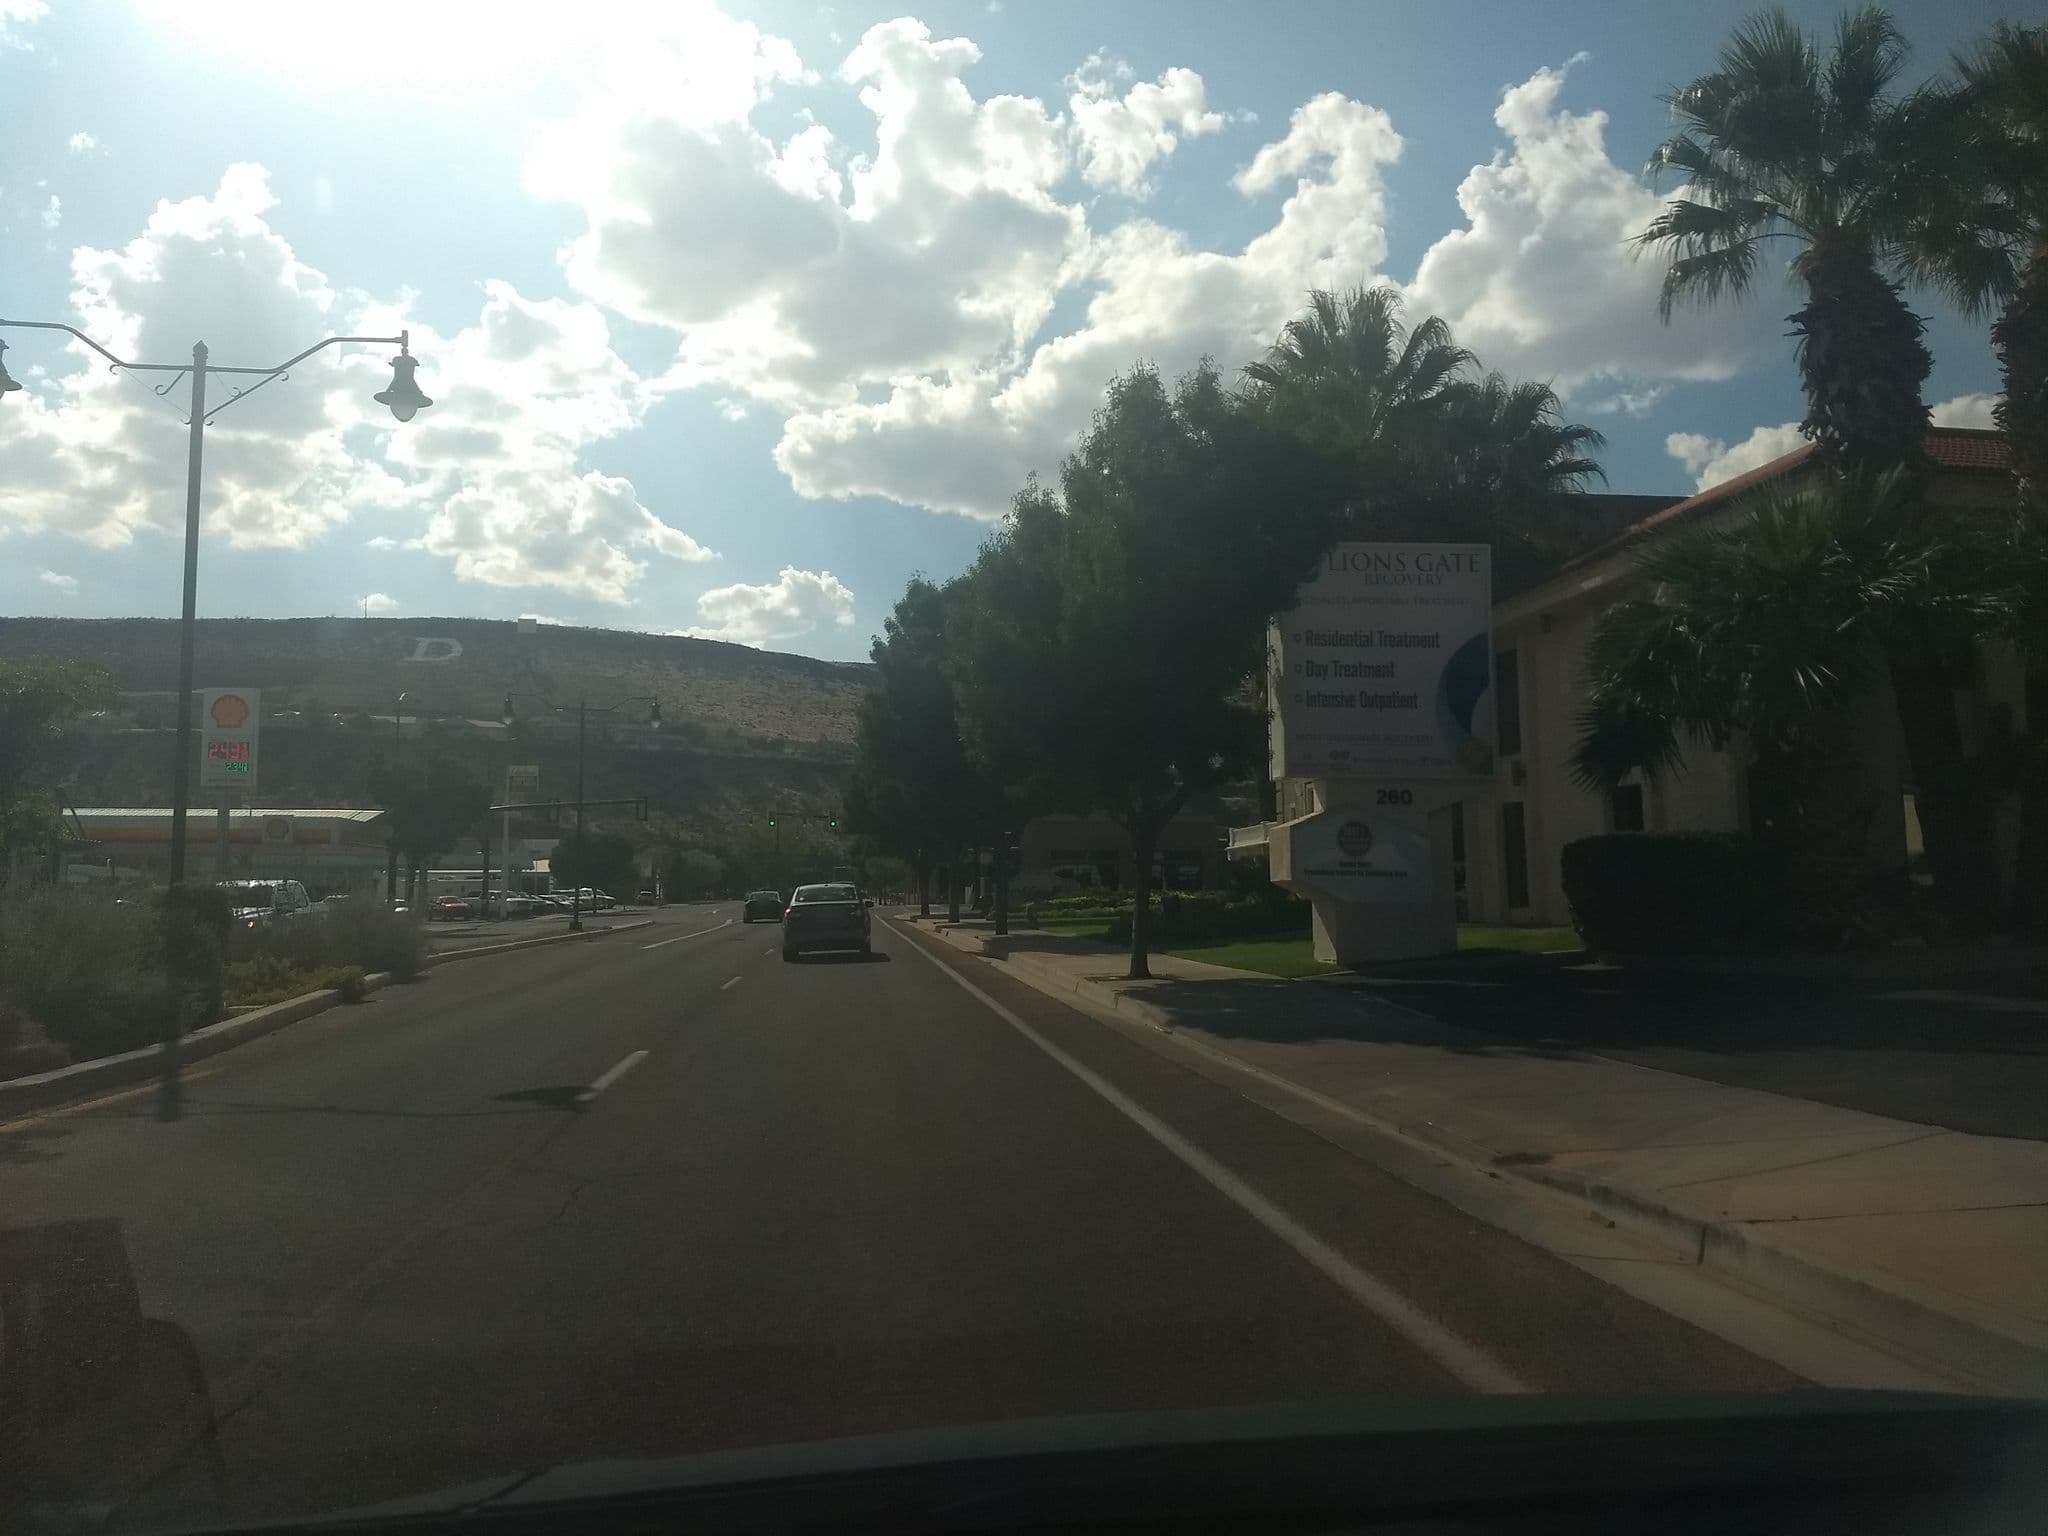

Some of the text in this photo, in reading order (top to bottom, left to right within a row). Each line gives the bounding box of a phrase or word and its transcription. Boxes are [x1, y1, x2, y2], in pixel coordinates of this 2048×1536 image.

[1328, 552, 1481, 574] LIONS GATE
[1364, 574, 1443, 586] RECOVERY
[1305, 630, 1441, 649] Residential Treatment
[1305, 659, 1396, 680] Day Treatment
[1306, 690, 1418, 712] Intensive Outpatient
[1375, 788, 1414, 806] 260
